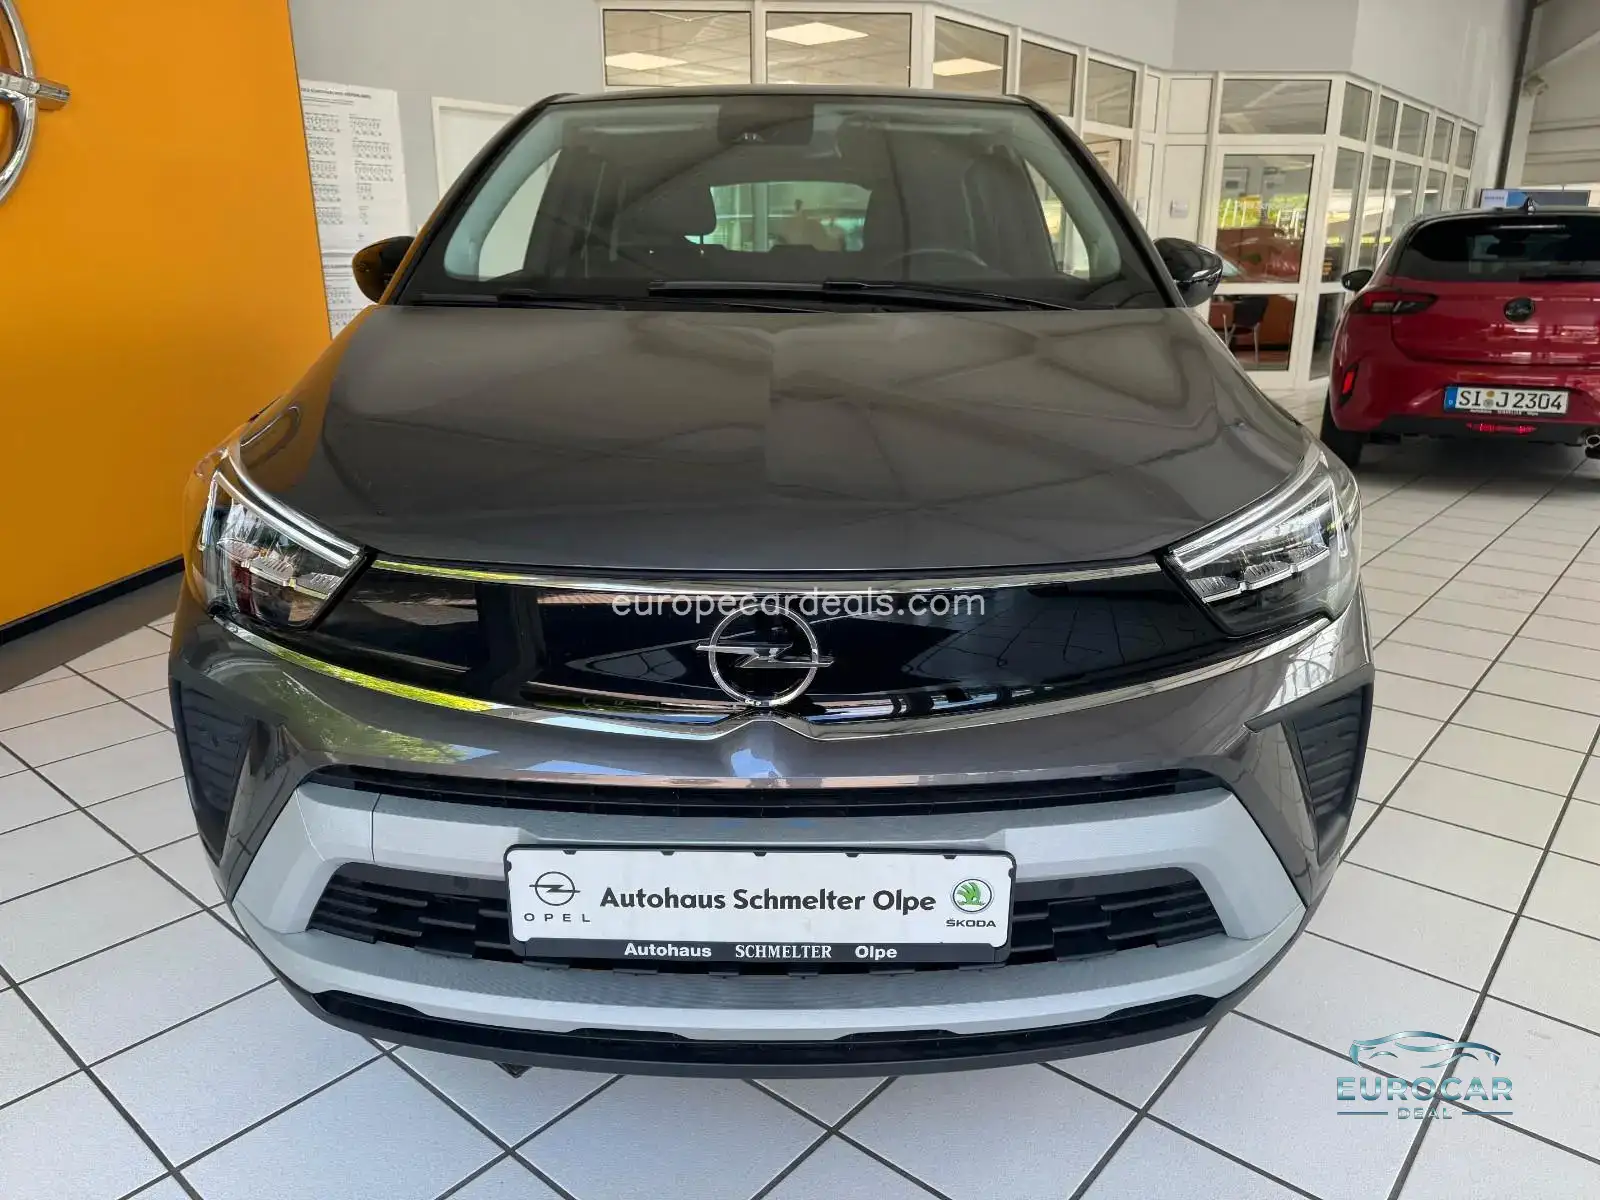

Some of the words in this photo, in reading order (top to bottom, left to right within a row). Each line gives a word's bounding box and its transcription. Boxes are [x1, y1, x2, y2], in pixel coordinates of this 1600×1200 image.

[1459, 390, 1481, 407] SI
[600, 887, 726, 910] Autohaus
[733, 888, 866, 911] Schmelter
[872, 889, 937, 916] Olpe
[523, 912, 591, 923] OPEL
[945, 917, 997, 928] ŠKODA
[624, 942, 712, 958] Autohaus
[735, 944, 832, 959] SCHMELTER
[854, 945, 898, 961] Olpe
